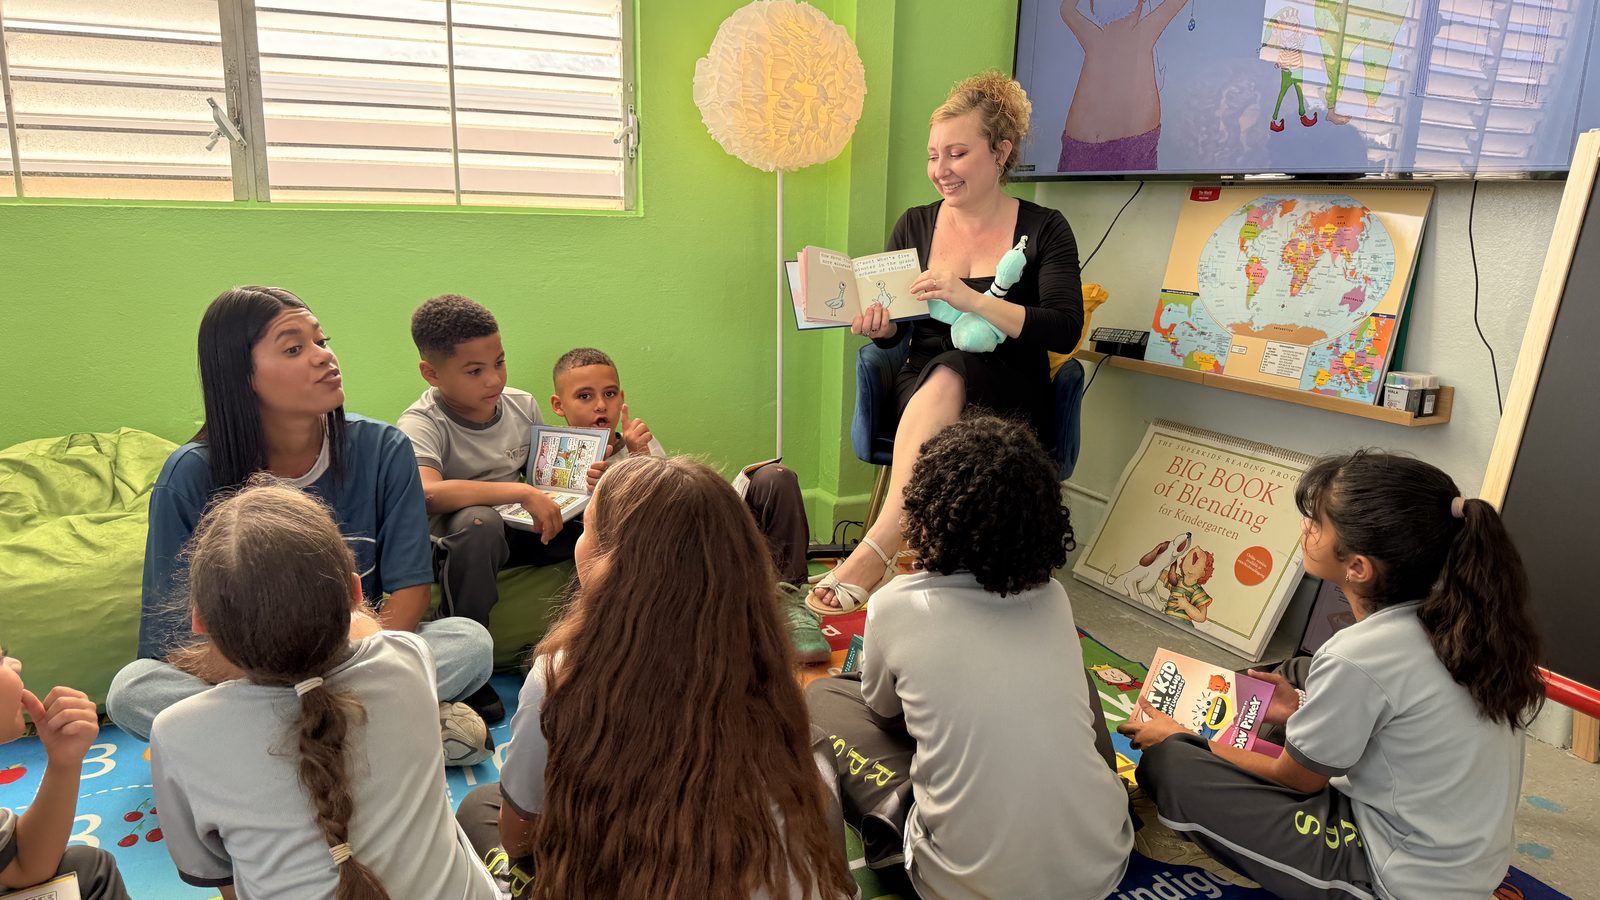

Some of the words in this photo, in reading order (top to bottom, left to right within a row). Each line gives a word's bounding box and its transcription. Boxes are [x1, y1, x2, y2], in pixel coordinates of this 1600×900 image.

[1176, 445, 1222, 460] SUPERKIDS
[1225, 458, 1266, 472] READING
[1166, 456, 1207, 482] BIG
[1208, 468, 1283, 505] BOOK
[1154, 480, 1179, 498] of
[1176, 483, 1269, 533] Blending
[1158, 504, 1173, 516] for
[1174, 509, 1240, 540] Kindergarten
